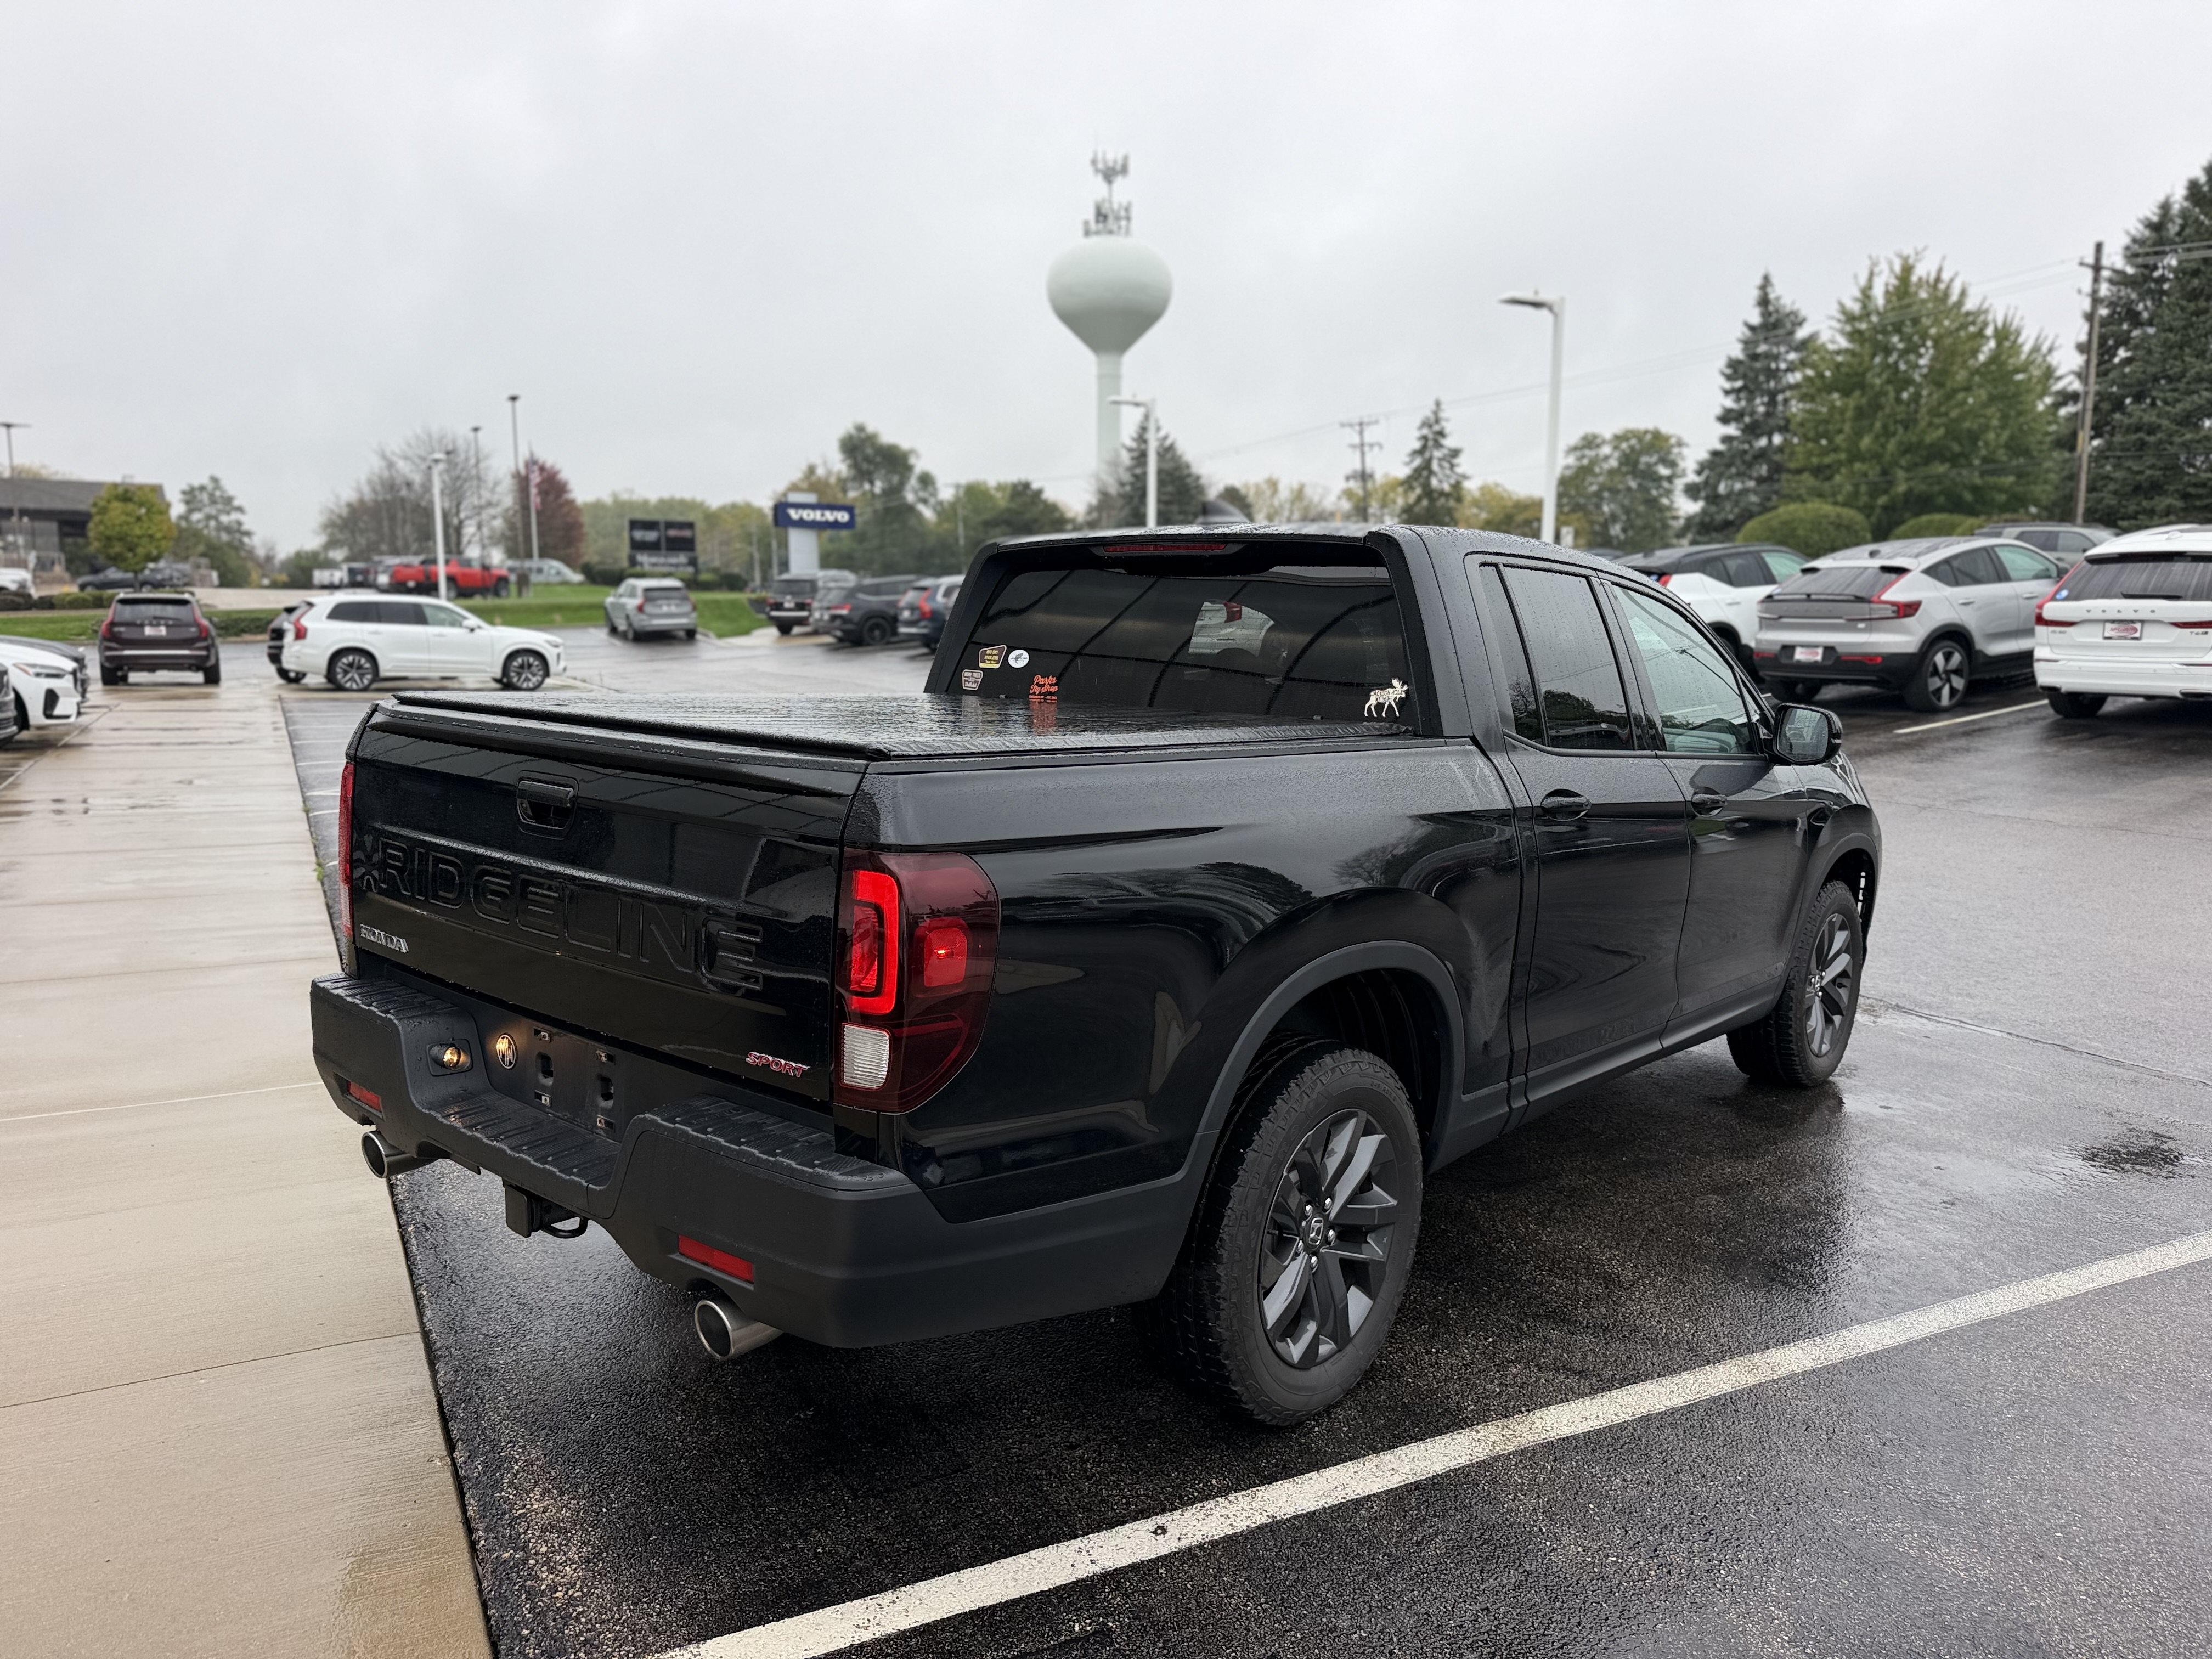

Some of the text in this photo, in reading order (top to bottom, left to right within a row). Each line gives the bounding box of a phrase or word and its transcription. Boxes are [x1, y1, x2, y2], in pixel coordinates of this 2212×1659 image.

[786, 507, 850, 523] VOLVO
[1029, 684, 1059, 695] Fly Shop
[1034, 675, 1058, 685] Parks
[380, 837, 763, 991] RIDGELINE
[360, 924, 409, 953] HONDA
[746, 1051, 810, 1078] SPORT
